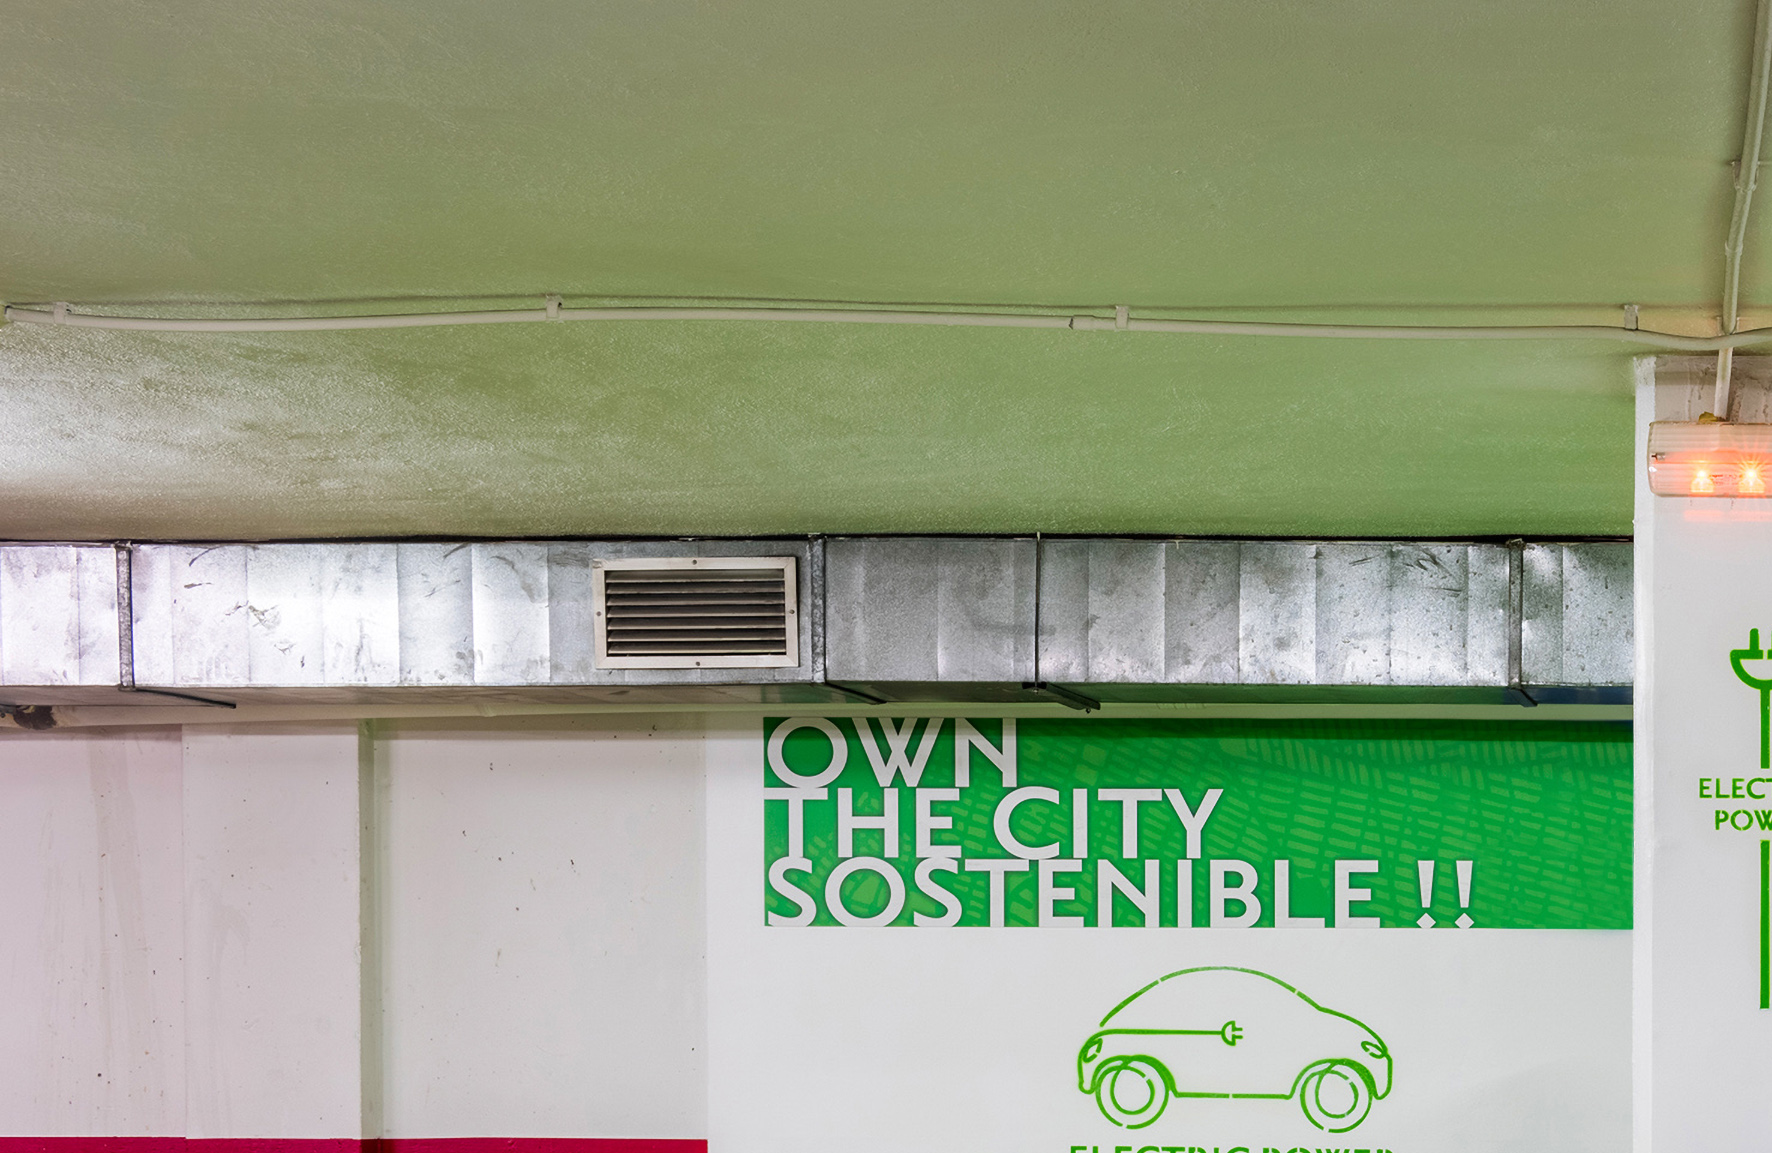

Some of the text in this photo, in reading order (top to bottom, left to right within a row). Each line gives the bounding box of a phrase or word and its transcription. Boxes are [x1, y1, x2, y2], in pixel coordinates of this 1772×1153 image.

[767, 717, 1018, 788] OWN
[764, 786, 1223, 860] THE CITY
[768, 856, 1475, 928] SOSTENIBLE !!
